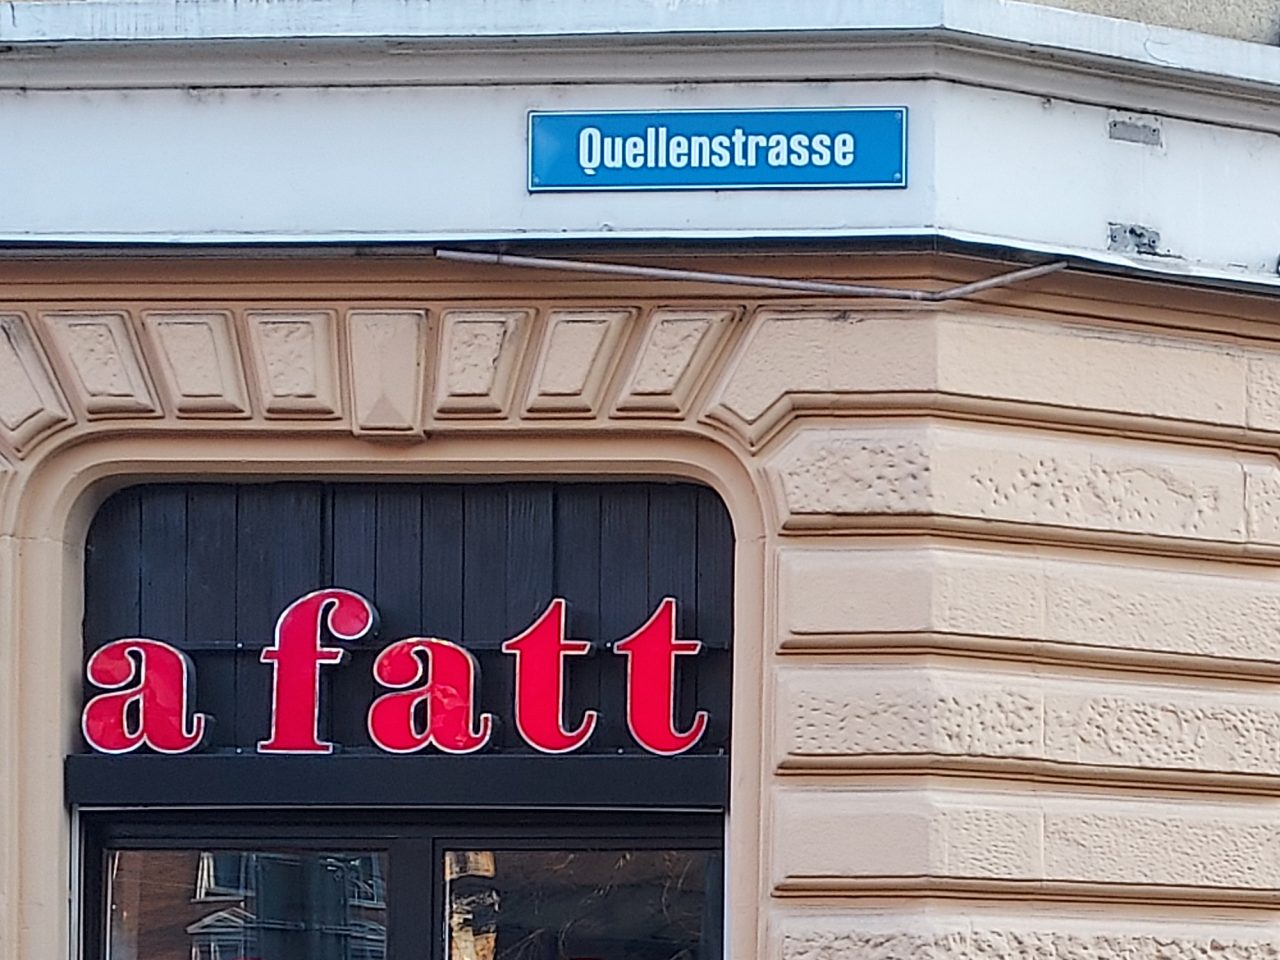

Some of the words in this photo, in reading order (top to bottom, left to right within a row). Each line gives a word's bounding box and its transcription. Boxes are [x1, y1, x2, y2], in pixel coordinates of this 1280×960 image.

[578, 127, 855, 174] Quellenstrasse
[82, 638, 206, 754] a
[257, 588, 709, 756] fatt
